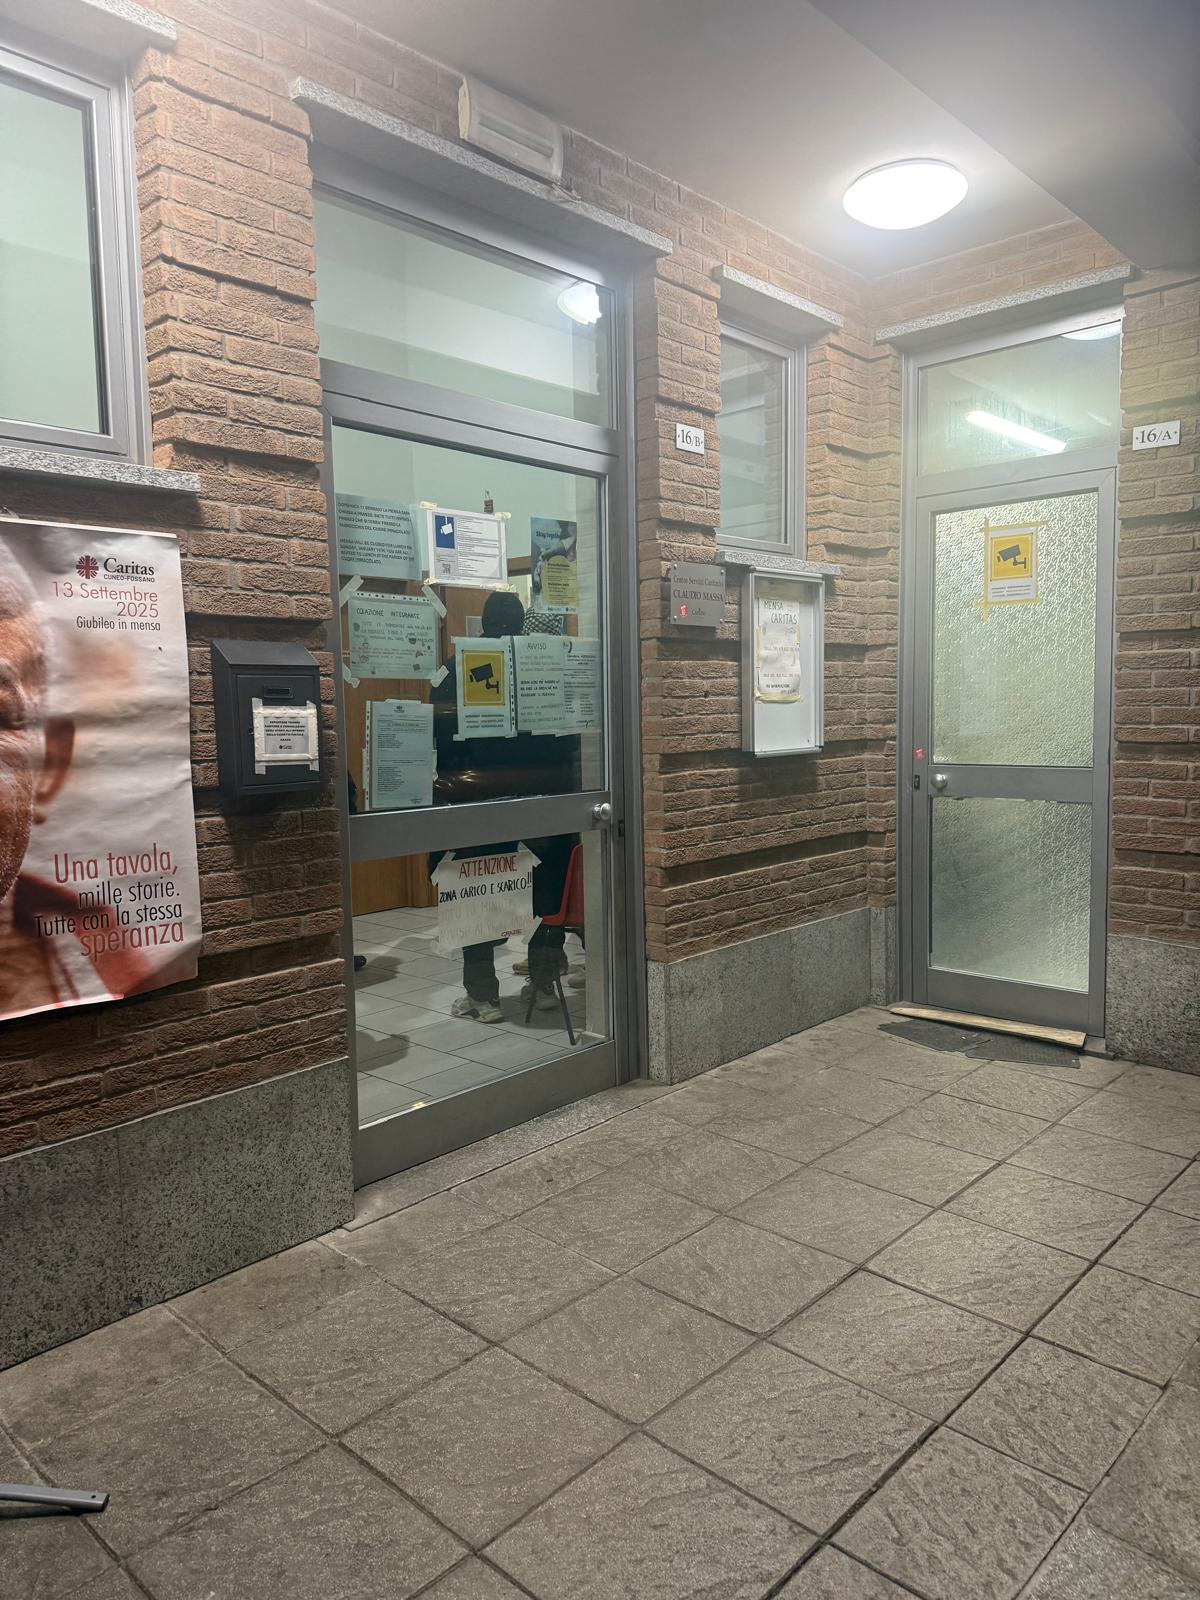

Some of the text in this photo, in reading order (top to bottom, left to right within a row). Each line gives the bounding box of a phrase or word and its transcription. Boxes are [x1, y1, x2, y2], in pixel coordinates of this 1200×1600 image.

[681, 430, 700, 446] 16/B
[1139, 428, 1172, 443] 16/A
[104, 558, 154, 576] Caritas
[104, 574, 155, 583] CUNEO-FOSSANO
[52, 582, 158, 602] 13 Settembre
[703, 592, 723, 602] MASSA
[116, 602, 159, 618] 2025
[764, 600, 783, 610] MENSA
[76, 616, 161, 631] Giubileo in mensa
[771, 613, 797, 625] CARITAS
[54, 843, 178, 883] Una tavola,
[459, 855, 517, 878] ATTENZIONE
[79, 876, 180, 908] mille storie.
[439, 872, 532, 903] ZONA CARICO E SCARICO!!
[34, 904, 182, 937] Tutte con la stessa
[81, 921, 184, 962] speranza
